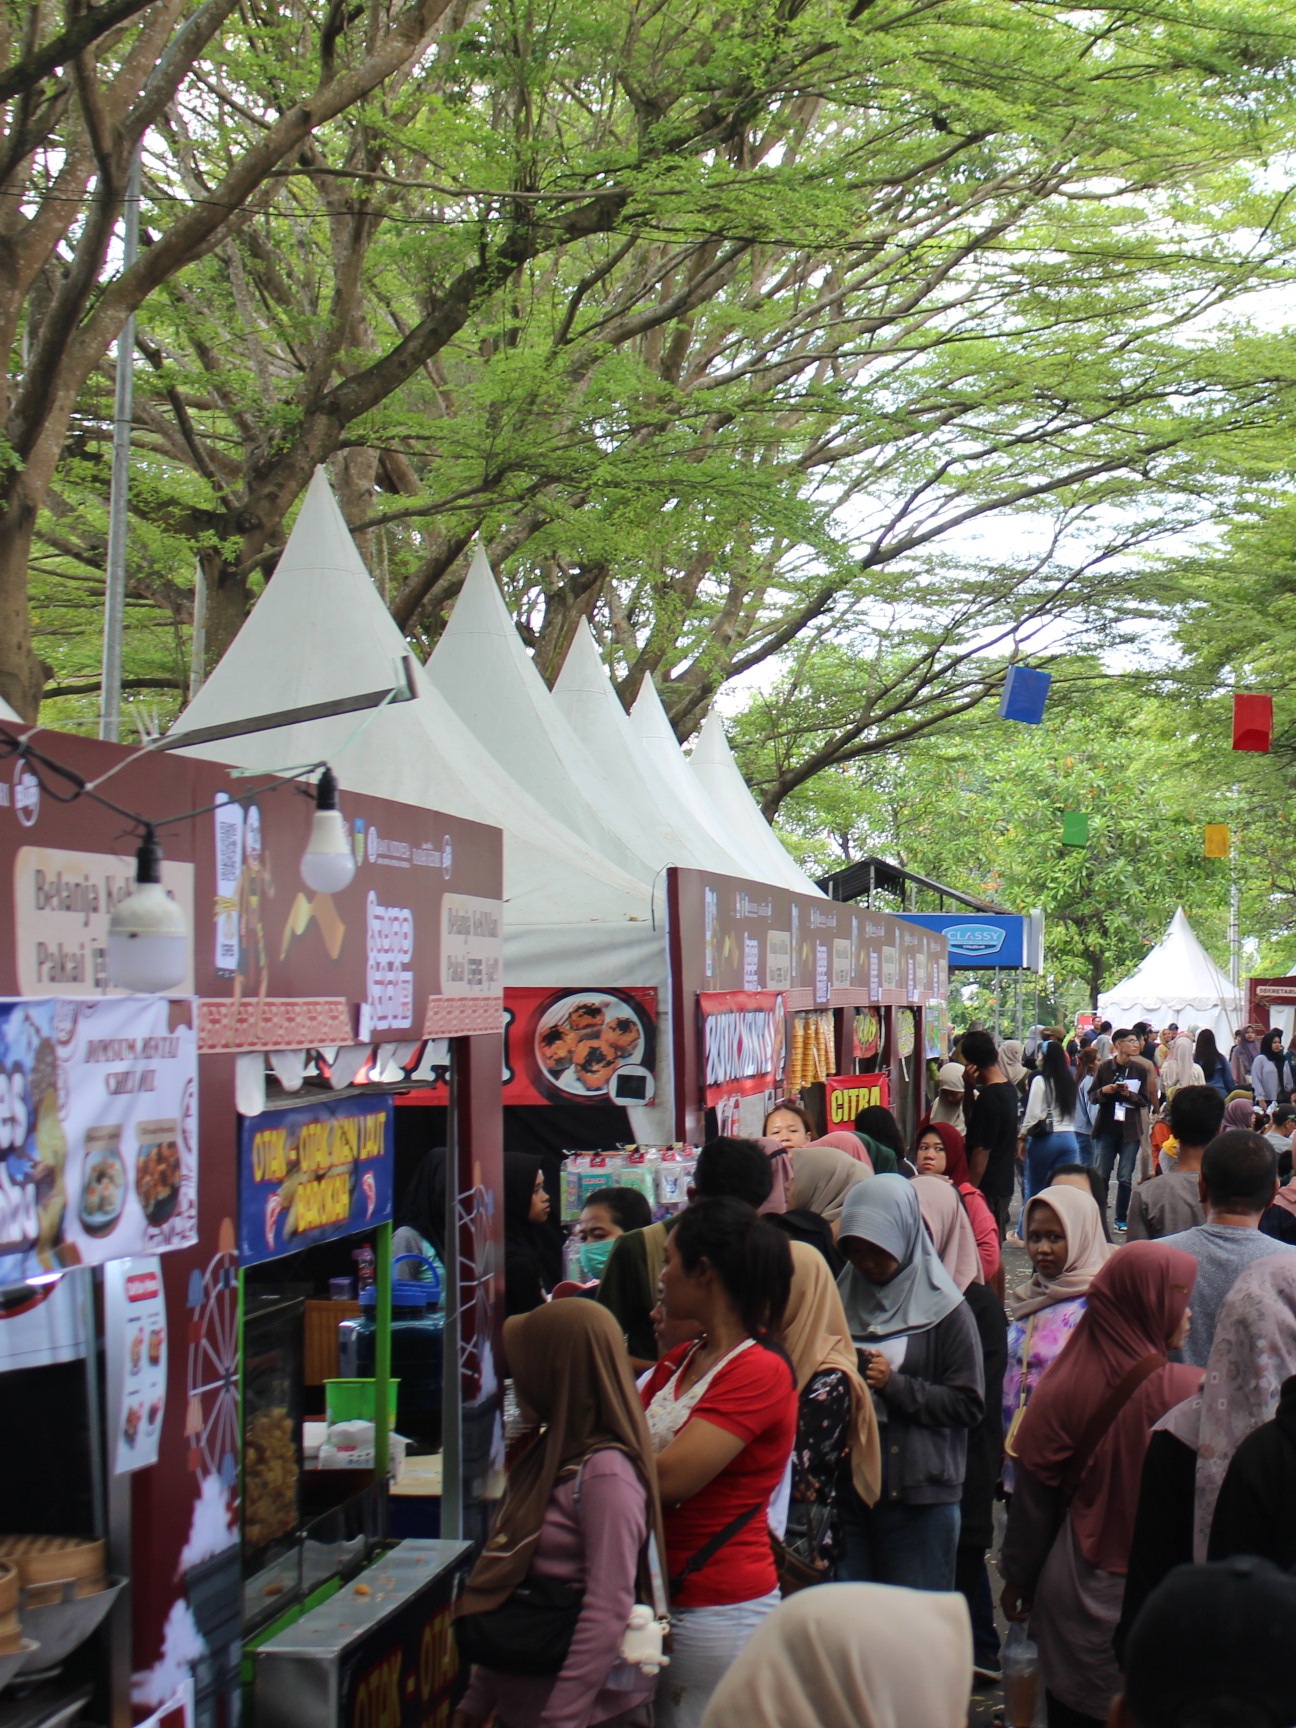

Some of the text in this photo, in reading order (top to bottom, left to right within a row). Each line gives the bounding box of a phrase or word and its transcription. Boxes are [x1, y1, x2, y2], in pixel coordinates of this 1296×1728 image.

[35, 869, 100, 927] Belanja
[36, 942, 85, 983] Pakai
[947, 930, 1000, 940] CLASSY
[252, 1126, 288, 1184] OTAK
[299, 1119, 332, 1173] OTAK
[359, 1110, 387, 1161] LAUT
[296, 1172, 350, 1234] BAROKAH
